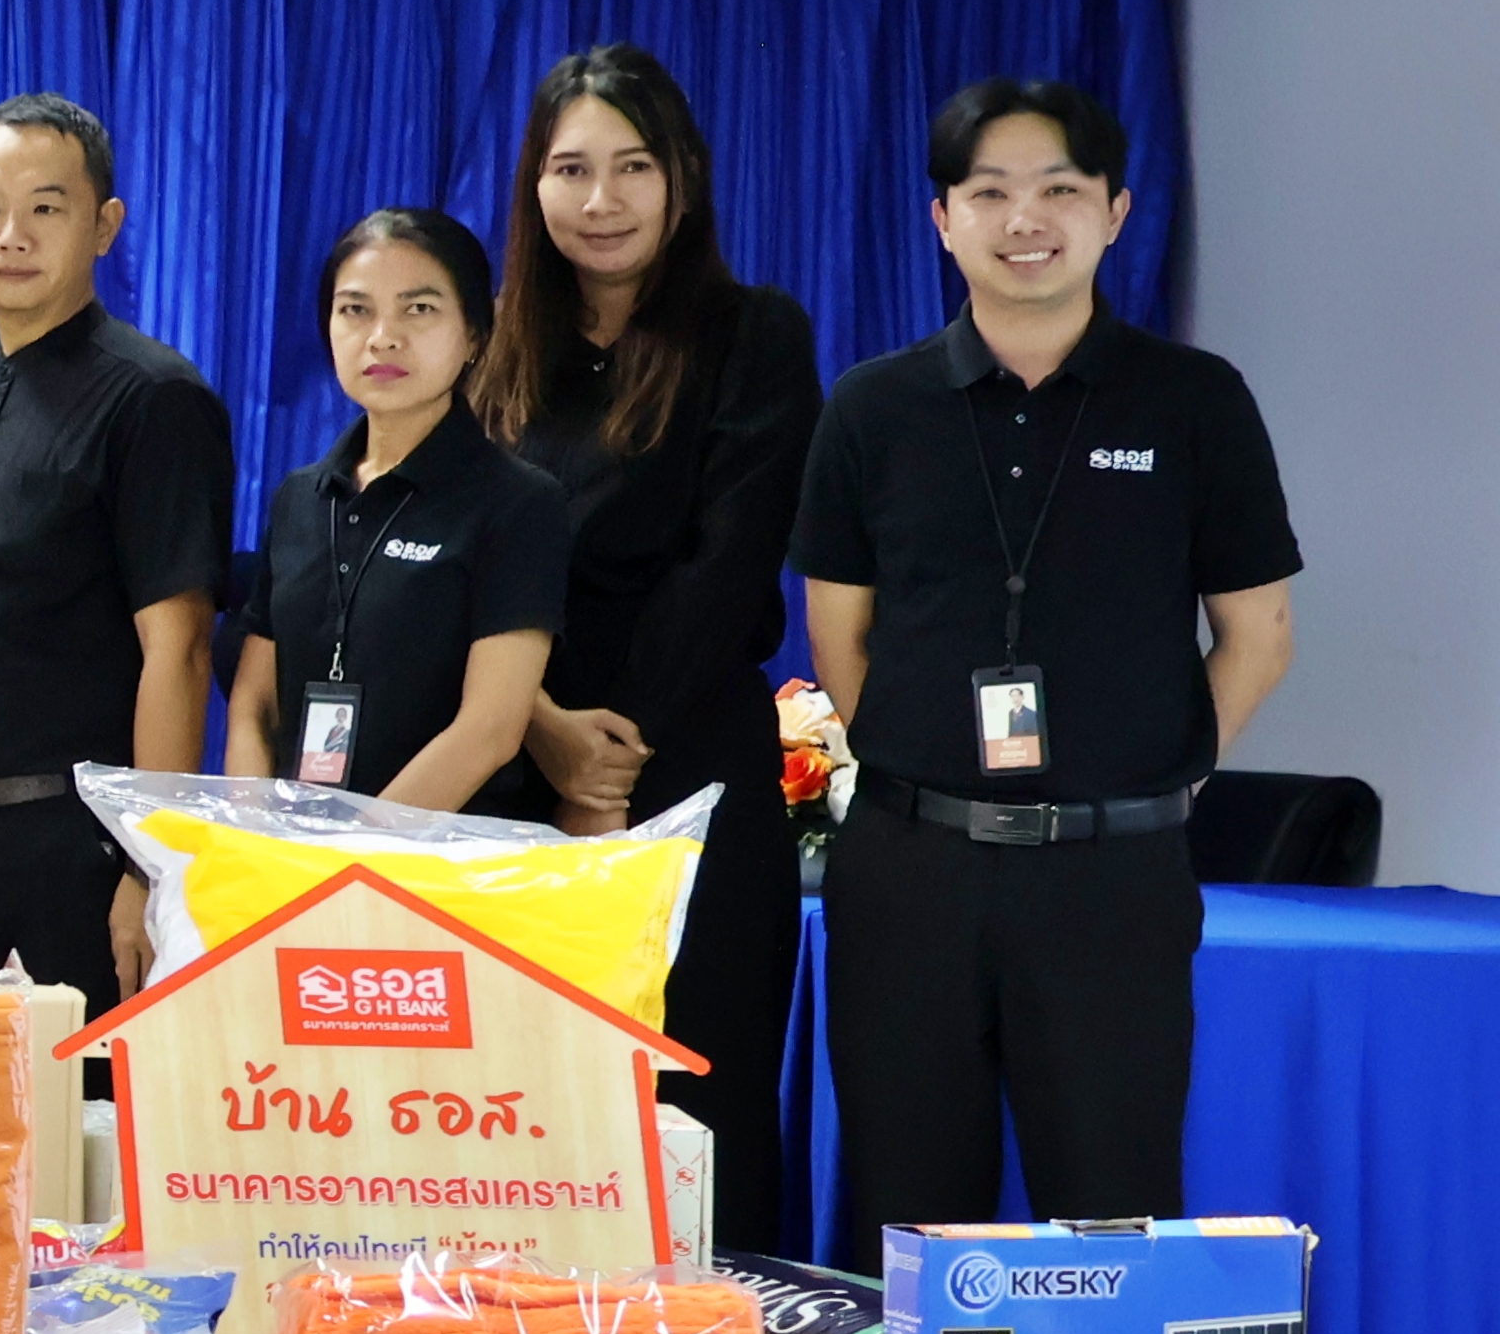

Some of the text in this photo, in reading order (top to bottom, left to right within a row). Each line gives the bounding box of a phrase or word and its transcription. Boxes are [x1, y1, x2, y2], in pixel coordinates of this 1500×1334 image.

[352, 966, 447, 1000] ธอส
[397, 1001, 449, 1017] BANK
[222, 1061, 546, 1140] บ้าน ธอส.
[165, 1170, 623, 1210] ธนาคารอาคารสงเคราะห์
[1010, 1269, 1126, 1297] KKSKY
